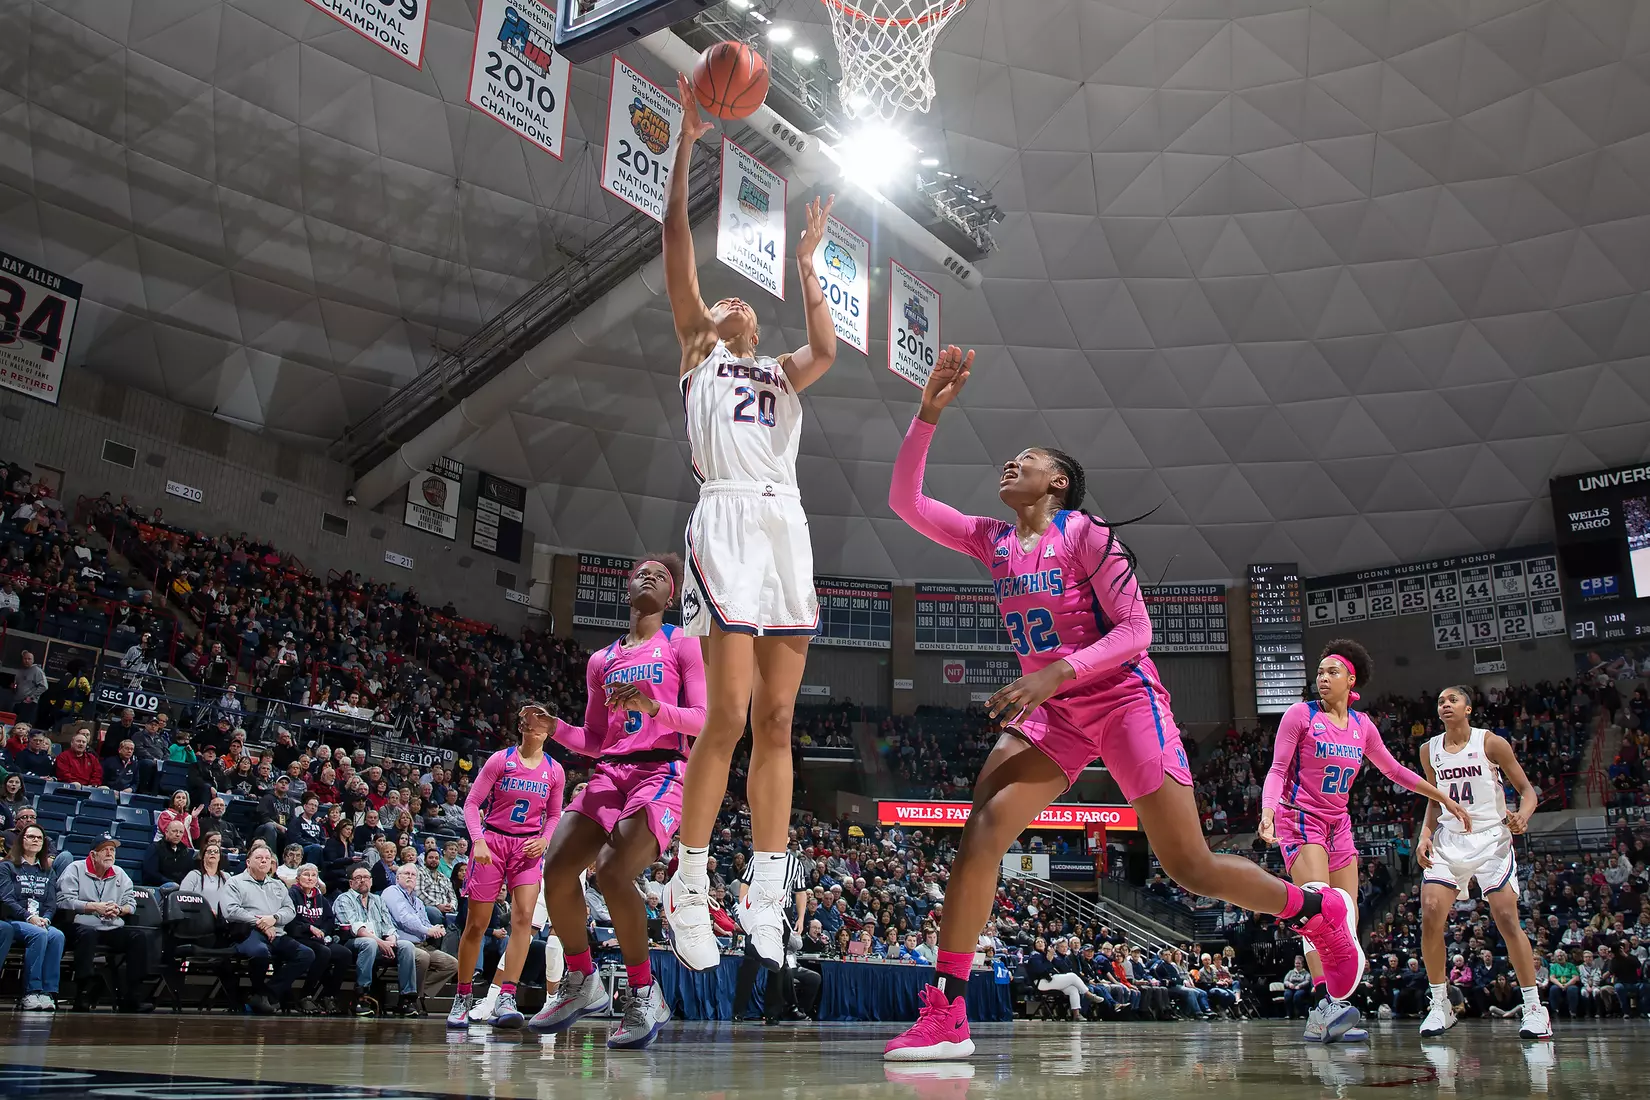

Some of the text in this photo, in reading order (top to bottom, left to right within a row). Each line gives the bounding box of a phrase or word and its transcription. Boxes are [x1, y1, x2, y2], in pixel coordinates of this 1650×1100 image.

[485, 51, 555, 113] 2010
[620, 64, 682, 114] UConn Women's
[487, 82, 549, 130] NATIONAL
[631, 83, 671, 117] Basketball
[480, 95, 552, 147] CHAMPIONS
[729, 142, 751, 164] UConn
[738, 161, 772, 189] Basketball
[618, 167, 664, 202] NATIONA
[612, 180, 661, 216] CHAMPIO
[826, 216, 839, 229] onn
[729, 212, 776, 262] 2014
[826, 225, 857, 252] Basketball
[730, 240, 774, 275] NATIONAL
[2, 257, 61, 289] RAY ALLEN
[726, 251, 777, 291] CHAMPIONS
[819, 275, 860, 318] 2015
[830, 306, 859, 332] TIONAL
[897, 327, 934, 367] 2016
[10, 371, 55, 393] RETIRED
[716, 363, 790, 395] UCONN
[895, 362, 926, 387] CHAMPIO
[733, 386, 776, 428] 20
[167, 483, 202, 500] SEC 210
[1568, 507, 1610, 522] WELLS
[1570, 517, 1611, 532] FARGO
[400, 557, 413, 568] 211
[581, 555, 601, 565] BIG
[1356, 552, 1497, 580] UCONN HUSKIES OF HONOR
[580, 564, 623, 576] REGULAR
[820, 580, 850, 588] ATHLETIC
[850, 581, 889, 590] CONFERENCE
[993, 566, 1065, 605] MEMPHIS
[1531, 573, 1557, 589] 42
[1580, 575, 1613, 591] CBS
[826, 588, 879, 598] CHAMPIONS
[921, 585, 995, 594] NATIONAL INVITATIO
[1143, 586, 1217, 596] AMPIONSHIP
[1434, 587, 1457, 602] 42
[1465, 582, 1489, 598] 44
[517, 594, 530, 604] 212
[832, 596, 889, 611] 2002 2004 2011
[1153, 595, 1219, 603] APPEARANCES
[1371, 596, 1393, 611] 22
[1402, 592, 1425, 608] 25
[939, 602, 954, 613] 1974
[1315, 605, 1328, 619] C
[1347, 601, 1356, 615] 9
[578, 616, 630, 629] CONNECTICU
[979, 617, 995, 628] 2001
[1472, 622, 1492, 638] 13
[1503, 617, 1526, 634] 22
[1575, 620, 1596, 639] 39
[1004, 606, 1063, 657] 32
[1437, 626, 1461, 642] 24
[1609, 629, 1626, 638] FULL
[836, 639, 887, 648] BASKETBALL
[947, 668, 962, 676] NIT
[965, 668, 1021, 677] NATIONAL INVITATI
[985, 661, 1010, 669] 1988
[1489, 663, 1506, 672] 214
[965, 676, 1001, 684] TOURNAMENT
[101, 689, 159, 711] SEC 109
[400, 752, 416, 762] SEC
[1315, 740, 1363, 764] MEMPHIS
[1321, 764, 1356, 795] 20
[1436, 765, 1483, 781] UCONN
[500, 776, 549, 799] MEMPHIS
[1449, 781, 1475, 805] 44
[509, 797, 532, 825] 2
[896, 806, 971, 820] WELLS FAR
[1074, 811, 1120, 823] FARGO
[1369, 846, 1387, 856] 113
[131, 889, 149, 899] ONN
[177, 894, 203, 904] UCONN
